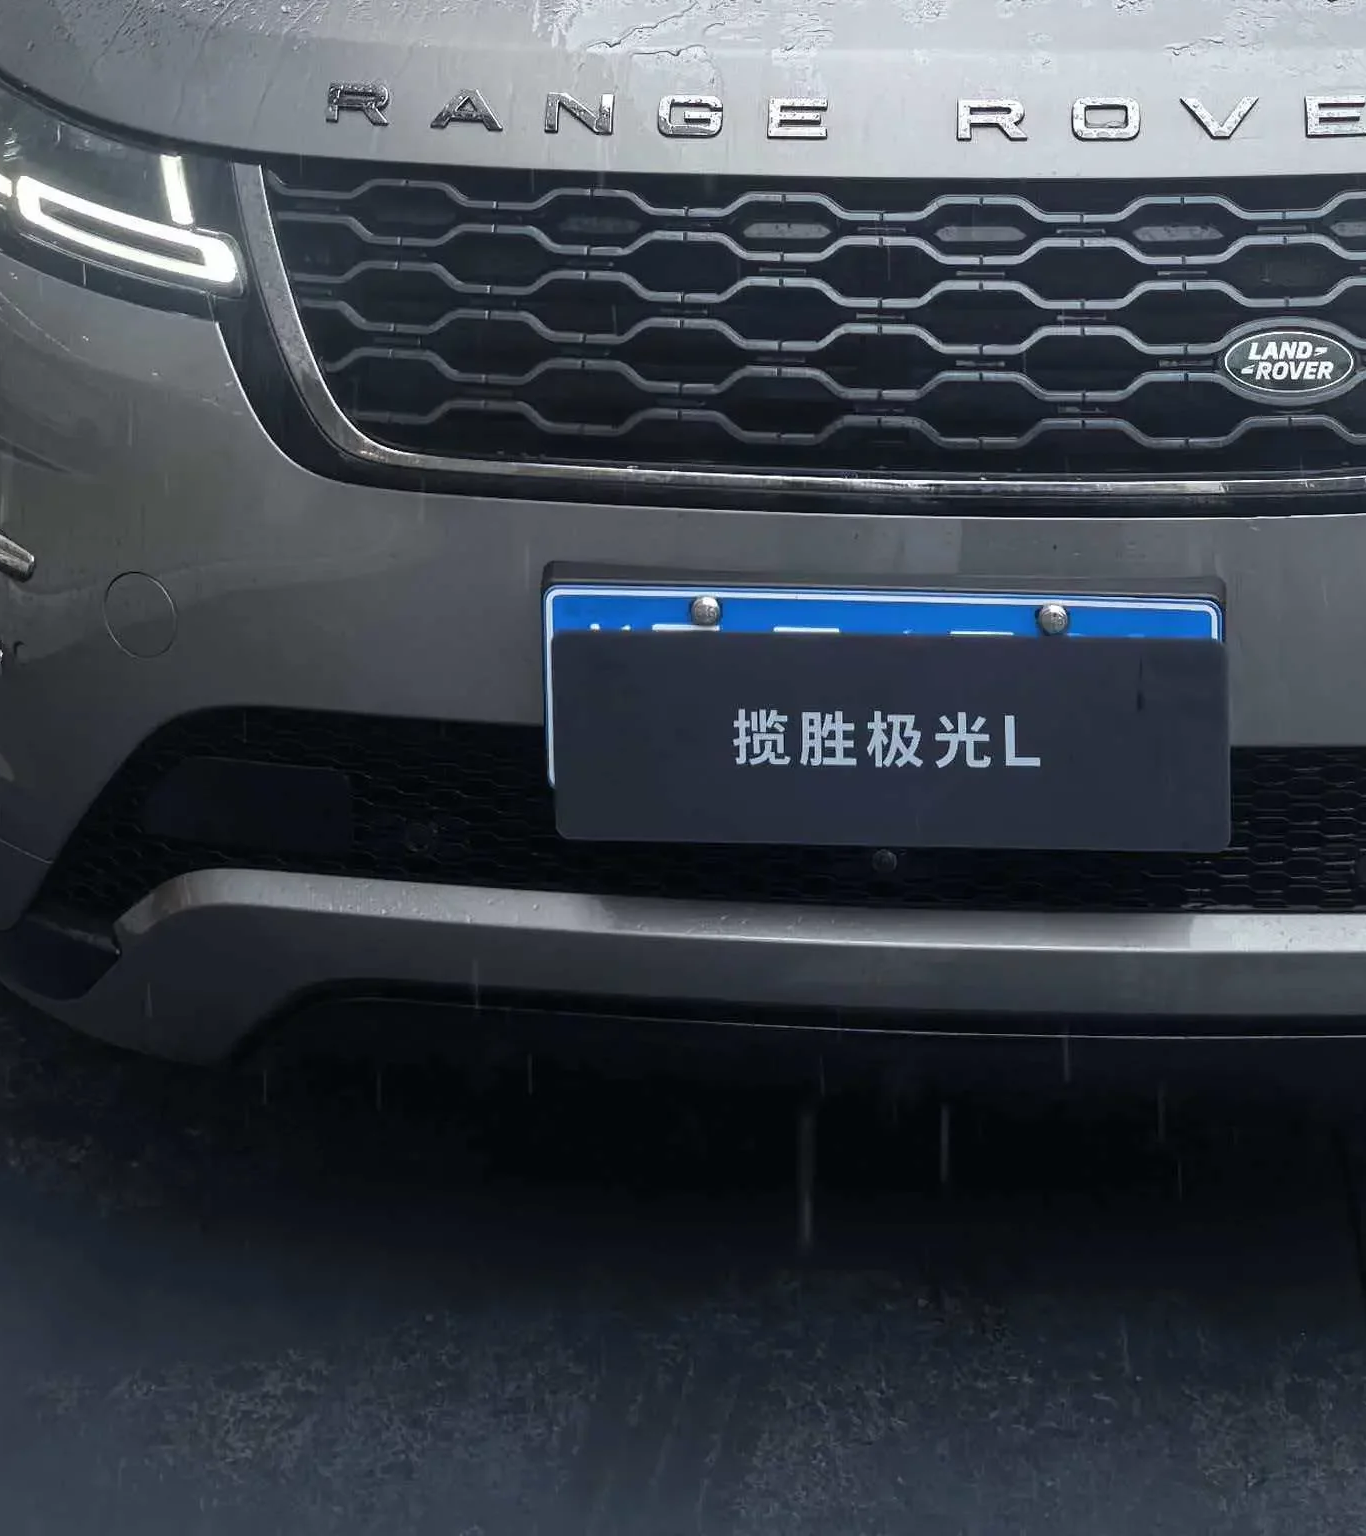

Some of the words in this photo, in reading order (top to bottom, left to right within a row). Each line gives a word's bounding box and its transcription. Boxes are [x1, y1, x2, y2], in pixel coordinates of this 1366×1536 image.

[325, 82, 829, 140] RANGE
[1247, 341, 1313, 361] LAND
[1255, 361, 1335, 381] ROVER
[732, 708, 1042, 769] 揽胜极光L
